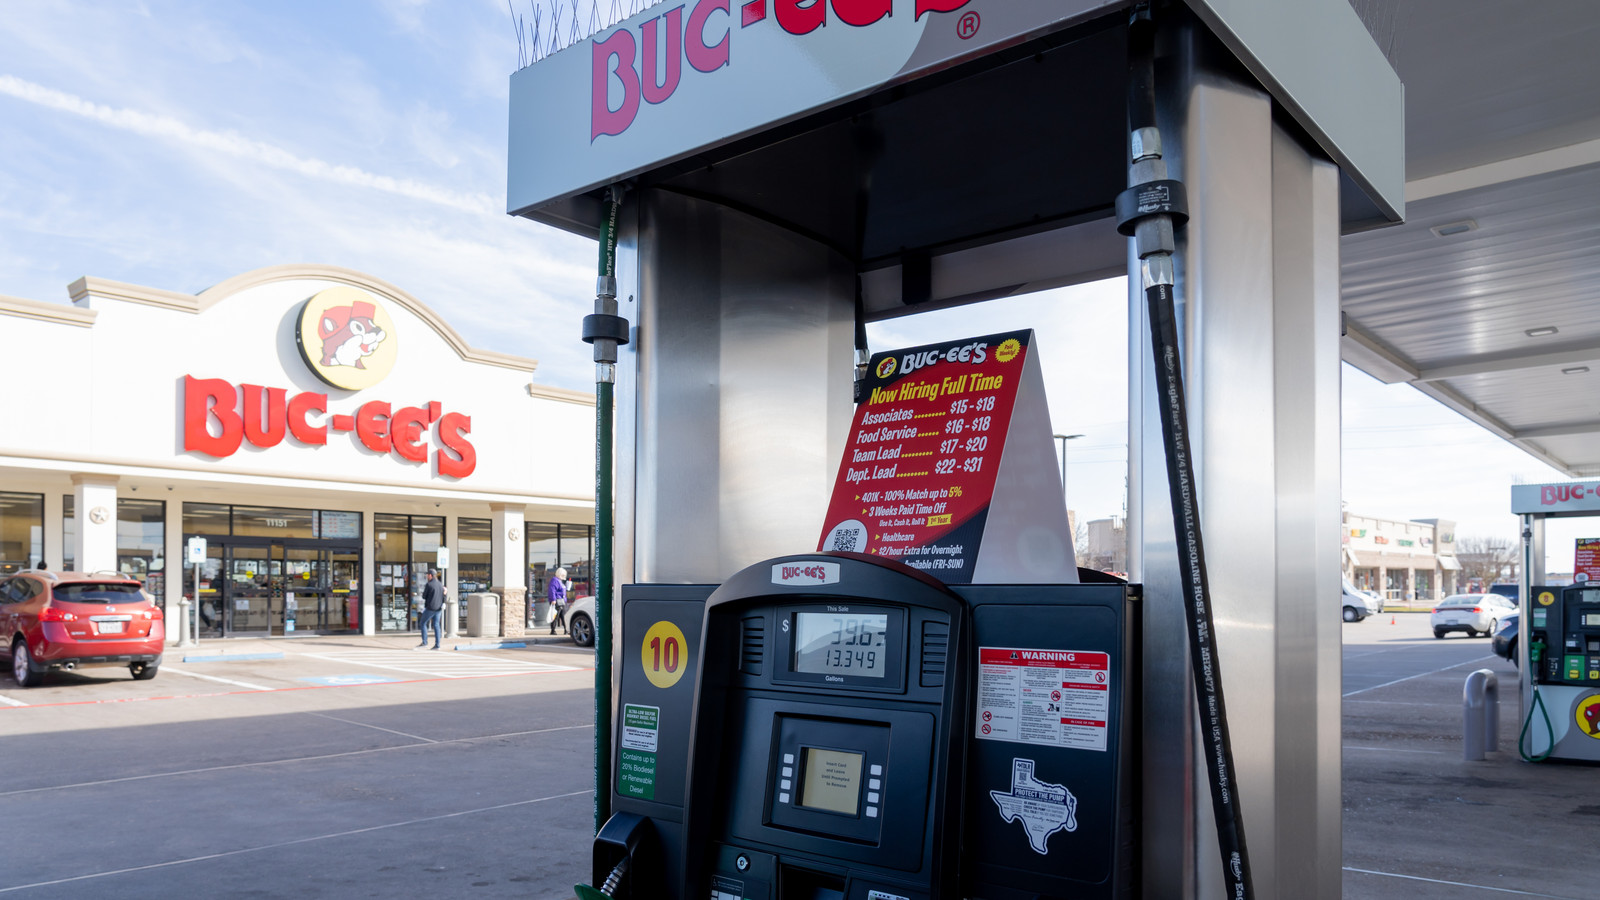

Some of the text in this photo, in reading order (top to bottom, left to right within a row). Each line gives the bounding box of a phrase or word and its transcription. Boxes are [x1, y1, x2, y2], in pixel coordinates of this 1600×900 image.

[899, 342, 988, 375] BUC-EE'S
[869, 373, 1003, 406] Now Hiring Full Time
[861, 409, 914, 426] Associates
[950, 399, 968, 414] $15
[976, 396, 995, 411] $18
[185, 374, 476, 478] BUC-EE'S
[856, 428, 879, 444] Food
[880, 425, 917, 442] Service
[945, 419, 964, 434] $16
[972, 416, 991, 431] $18
[852, 449, 880, 463] Team
[880, 444, 902, 460] Lead
[940, 439, 959, 454] $17
[966, 436, 988, 452] $20
[1175, 432, 1185, 450] HW
[1177, 452, 1186, 468] 3/4
[846, 468, 870, 485] Dept.
[872, 464, 898, 480] Lead
[935, 459, 956, 474] $22
[964, 457, 983, 472] $31
[862, 492, 880, 502] 401K
[884, 490, 905, 501] 100%
[906, 488, 928, 500] Match
[929, 490, 939, 501] up
[940, 488, 948, 498] to
[948, 486, 962, 498] 5%
[1179, 470, 1193, 529] HARDWALL
[1541, 485, 1600, 505] BUC-
[869, 502, 947, 517] 3 Weeks Paid Time Off
[266, 519, 287, 527] 11151
[882, 532, 915, 541] Healthcare
[879, 546, 903, 556] $2/hour
[903, 546, 923, 555] Extra
[931, 544, 963, 556] Overnight
[1187, 530, 1200, 584] GASOLINE
[932, 559, 964, 569] (FRI-SUN)
[782, 566, 826, 580] BUC-EE'S
[1194, 584, 1205, 614] HOSE
[782, 619, 789, 633] $
[650, 636, 679, 673] 10
[826, 650, 876, 669] 13.349
[1022, 651, 1075, 661] WARNING
[1208, 696, 1219, 716] Made
[1212, 725, 1221, 742] USA
[622, 752, 642, 762] Contains
[633, 764, 654, 774] Biodiesel
[1215, 744, 1229, 804] www.husky.com
[628, 774, 653, 785] Renewable
[630, 785, 643, 794] Diesel
[1015, 789, 1038, 797] PROTECT
